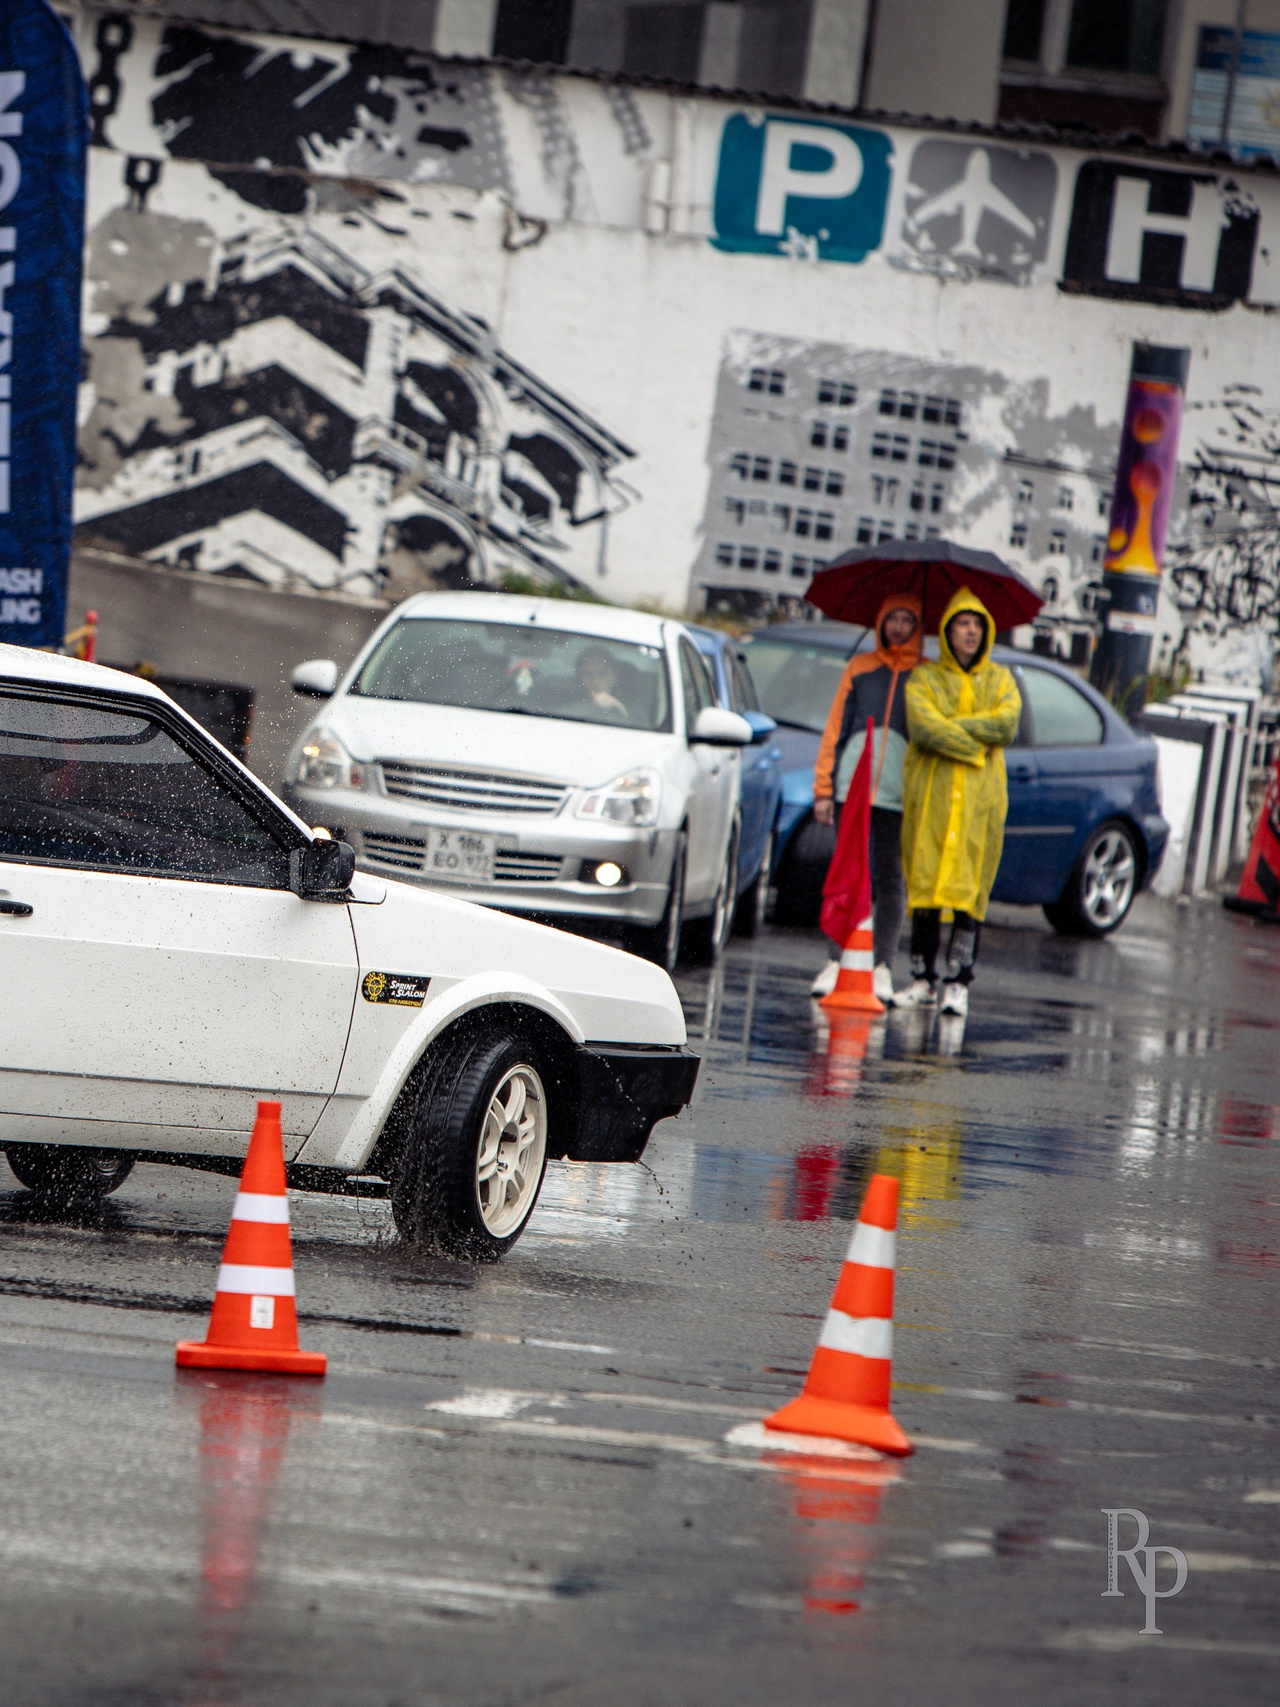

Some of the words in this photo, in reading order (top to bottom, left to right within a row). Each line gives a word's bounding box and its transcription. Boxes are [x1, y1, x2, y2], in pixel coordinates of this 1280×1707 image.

[755, 121, 864, 237] P
[1105, 176, 1224, 293] H
[389, 980, 417, 991] SPRINT
[396, 989, 426, 999] SLALOM
